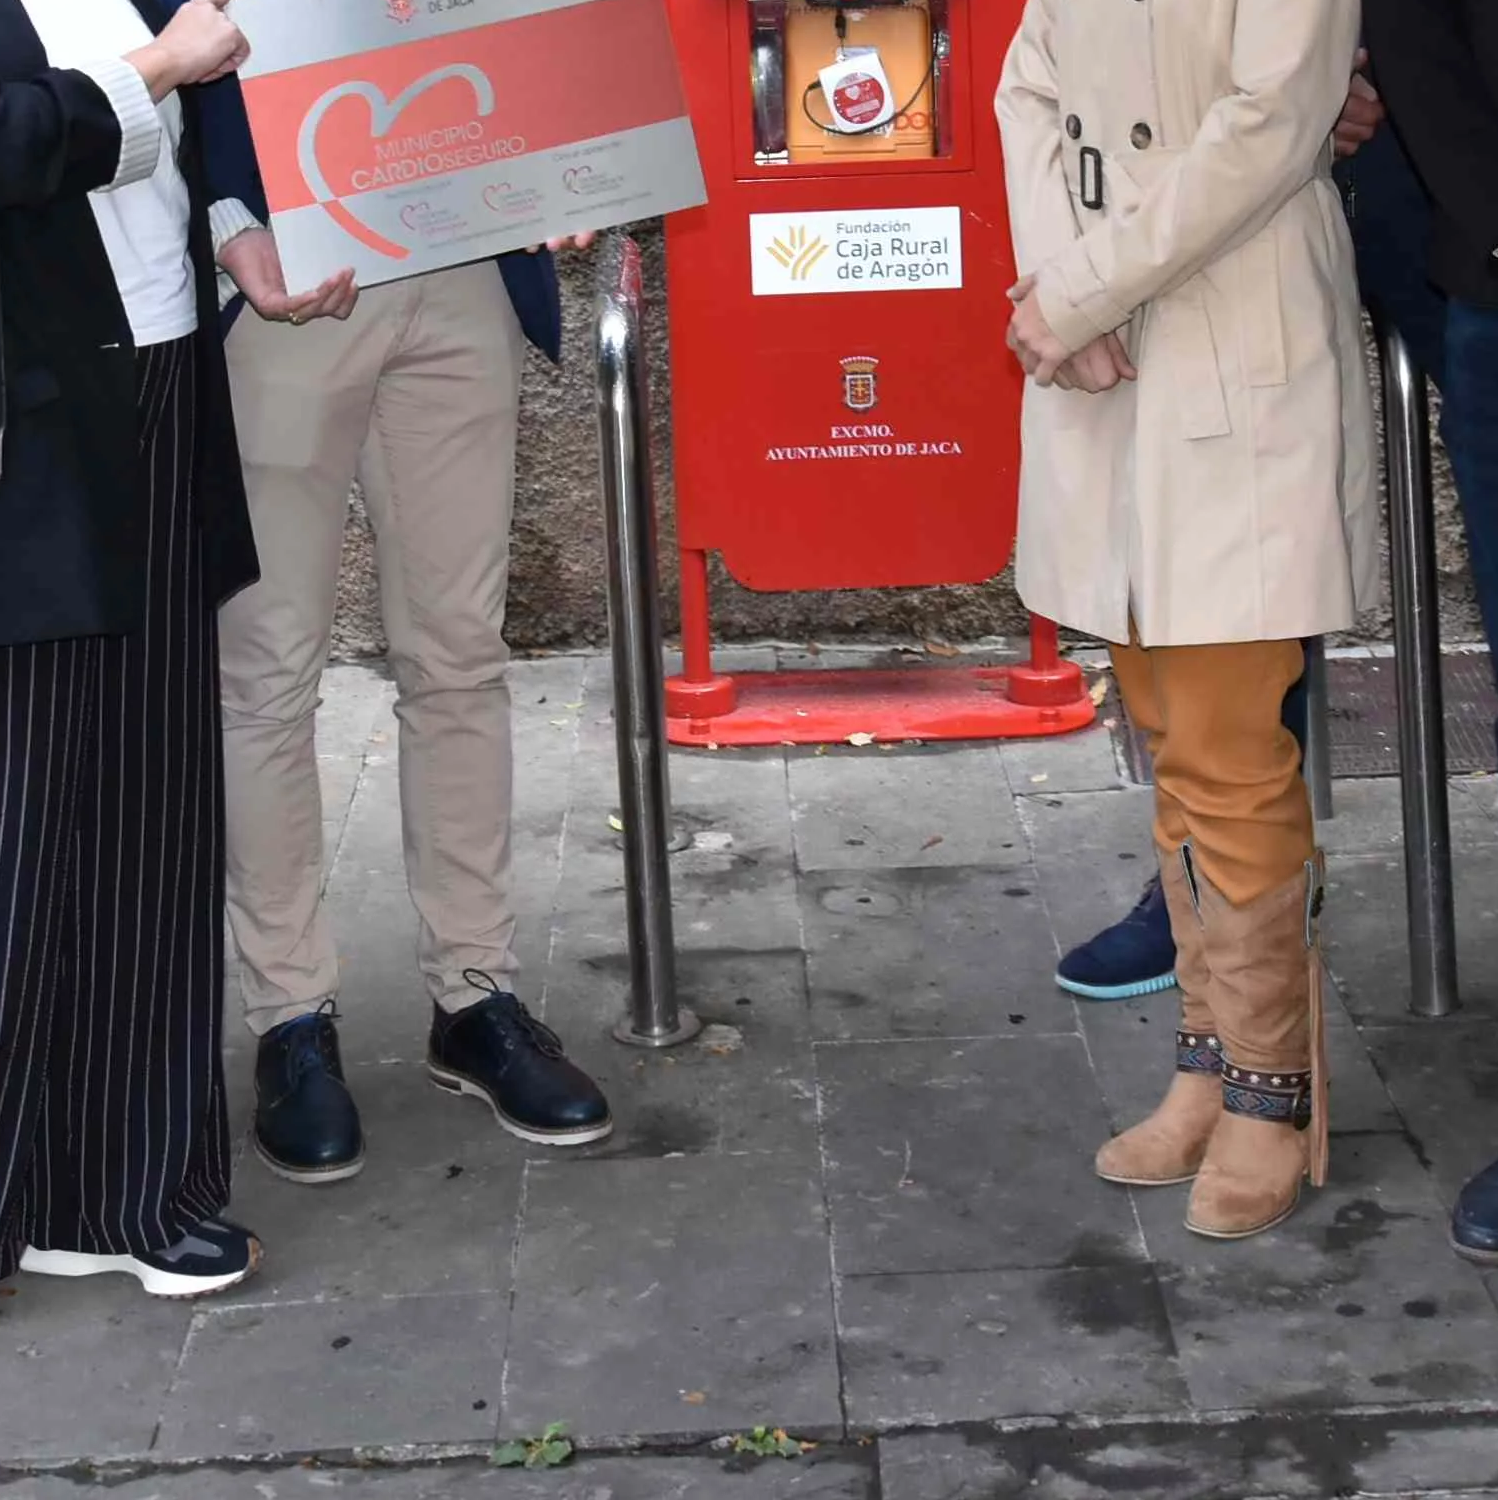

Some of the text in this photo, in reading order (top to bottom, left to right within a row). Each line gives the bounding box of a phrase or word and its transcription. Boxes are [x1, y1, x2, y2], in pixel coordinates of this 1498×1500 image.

[428, 0, 443, 14] DE
[375, 121, 483, 162] MUNICIPIO
[351, 136, 526, 190] CARDIOSEGURO
[836, 221, 911, 234] Fundación
[836, 237, 948, 260] Caja Rural
[837, 258, 949, 281] de Aragón
[831, 424, 894, 439] EXCMO.
[765, 441, 962, 461] AYUNTAMIENTO DE JACA
